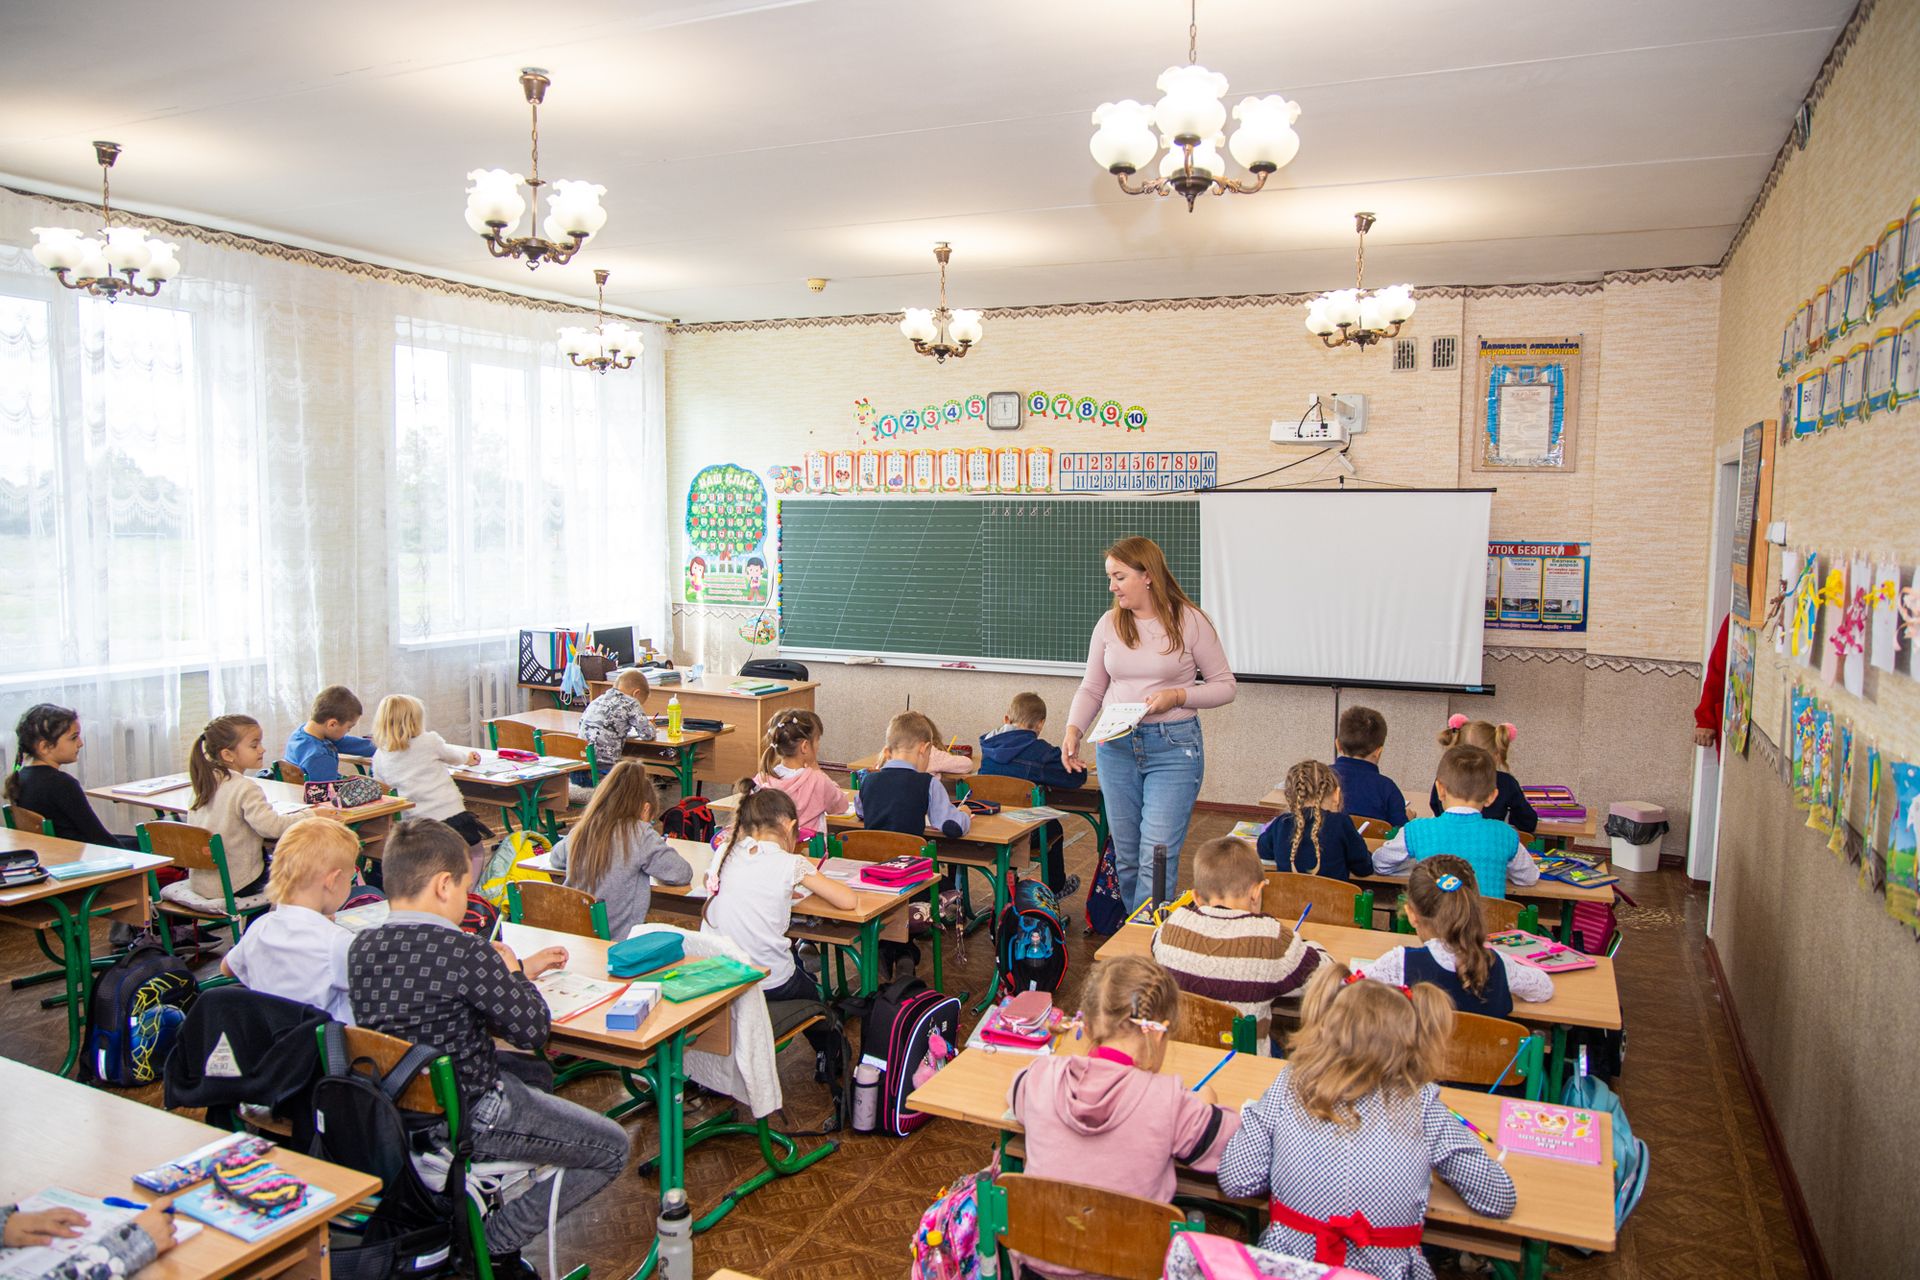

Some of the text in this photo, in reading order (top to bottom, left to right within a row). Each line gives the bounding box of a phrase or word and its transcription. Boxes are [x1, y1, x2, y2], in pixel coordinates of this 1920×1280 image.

[884, 396, 1143, 433] 1 2 3 4 5 6 7 8 9 10
[1063, 456, 1214, 470] 0 1 2 3 4 5 6 7 8 9 10
[1076, 475, 1214, 489] 11 12 13 14 15 16 17 18 19 20
[1517, 545, 1565, 556] БЕЗПЕКИ
